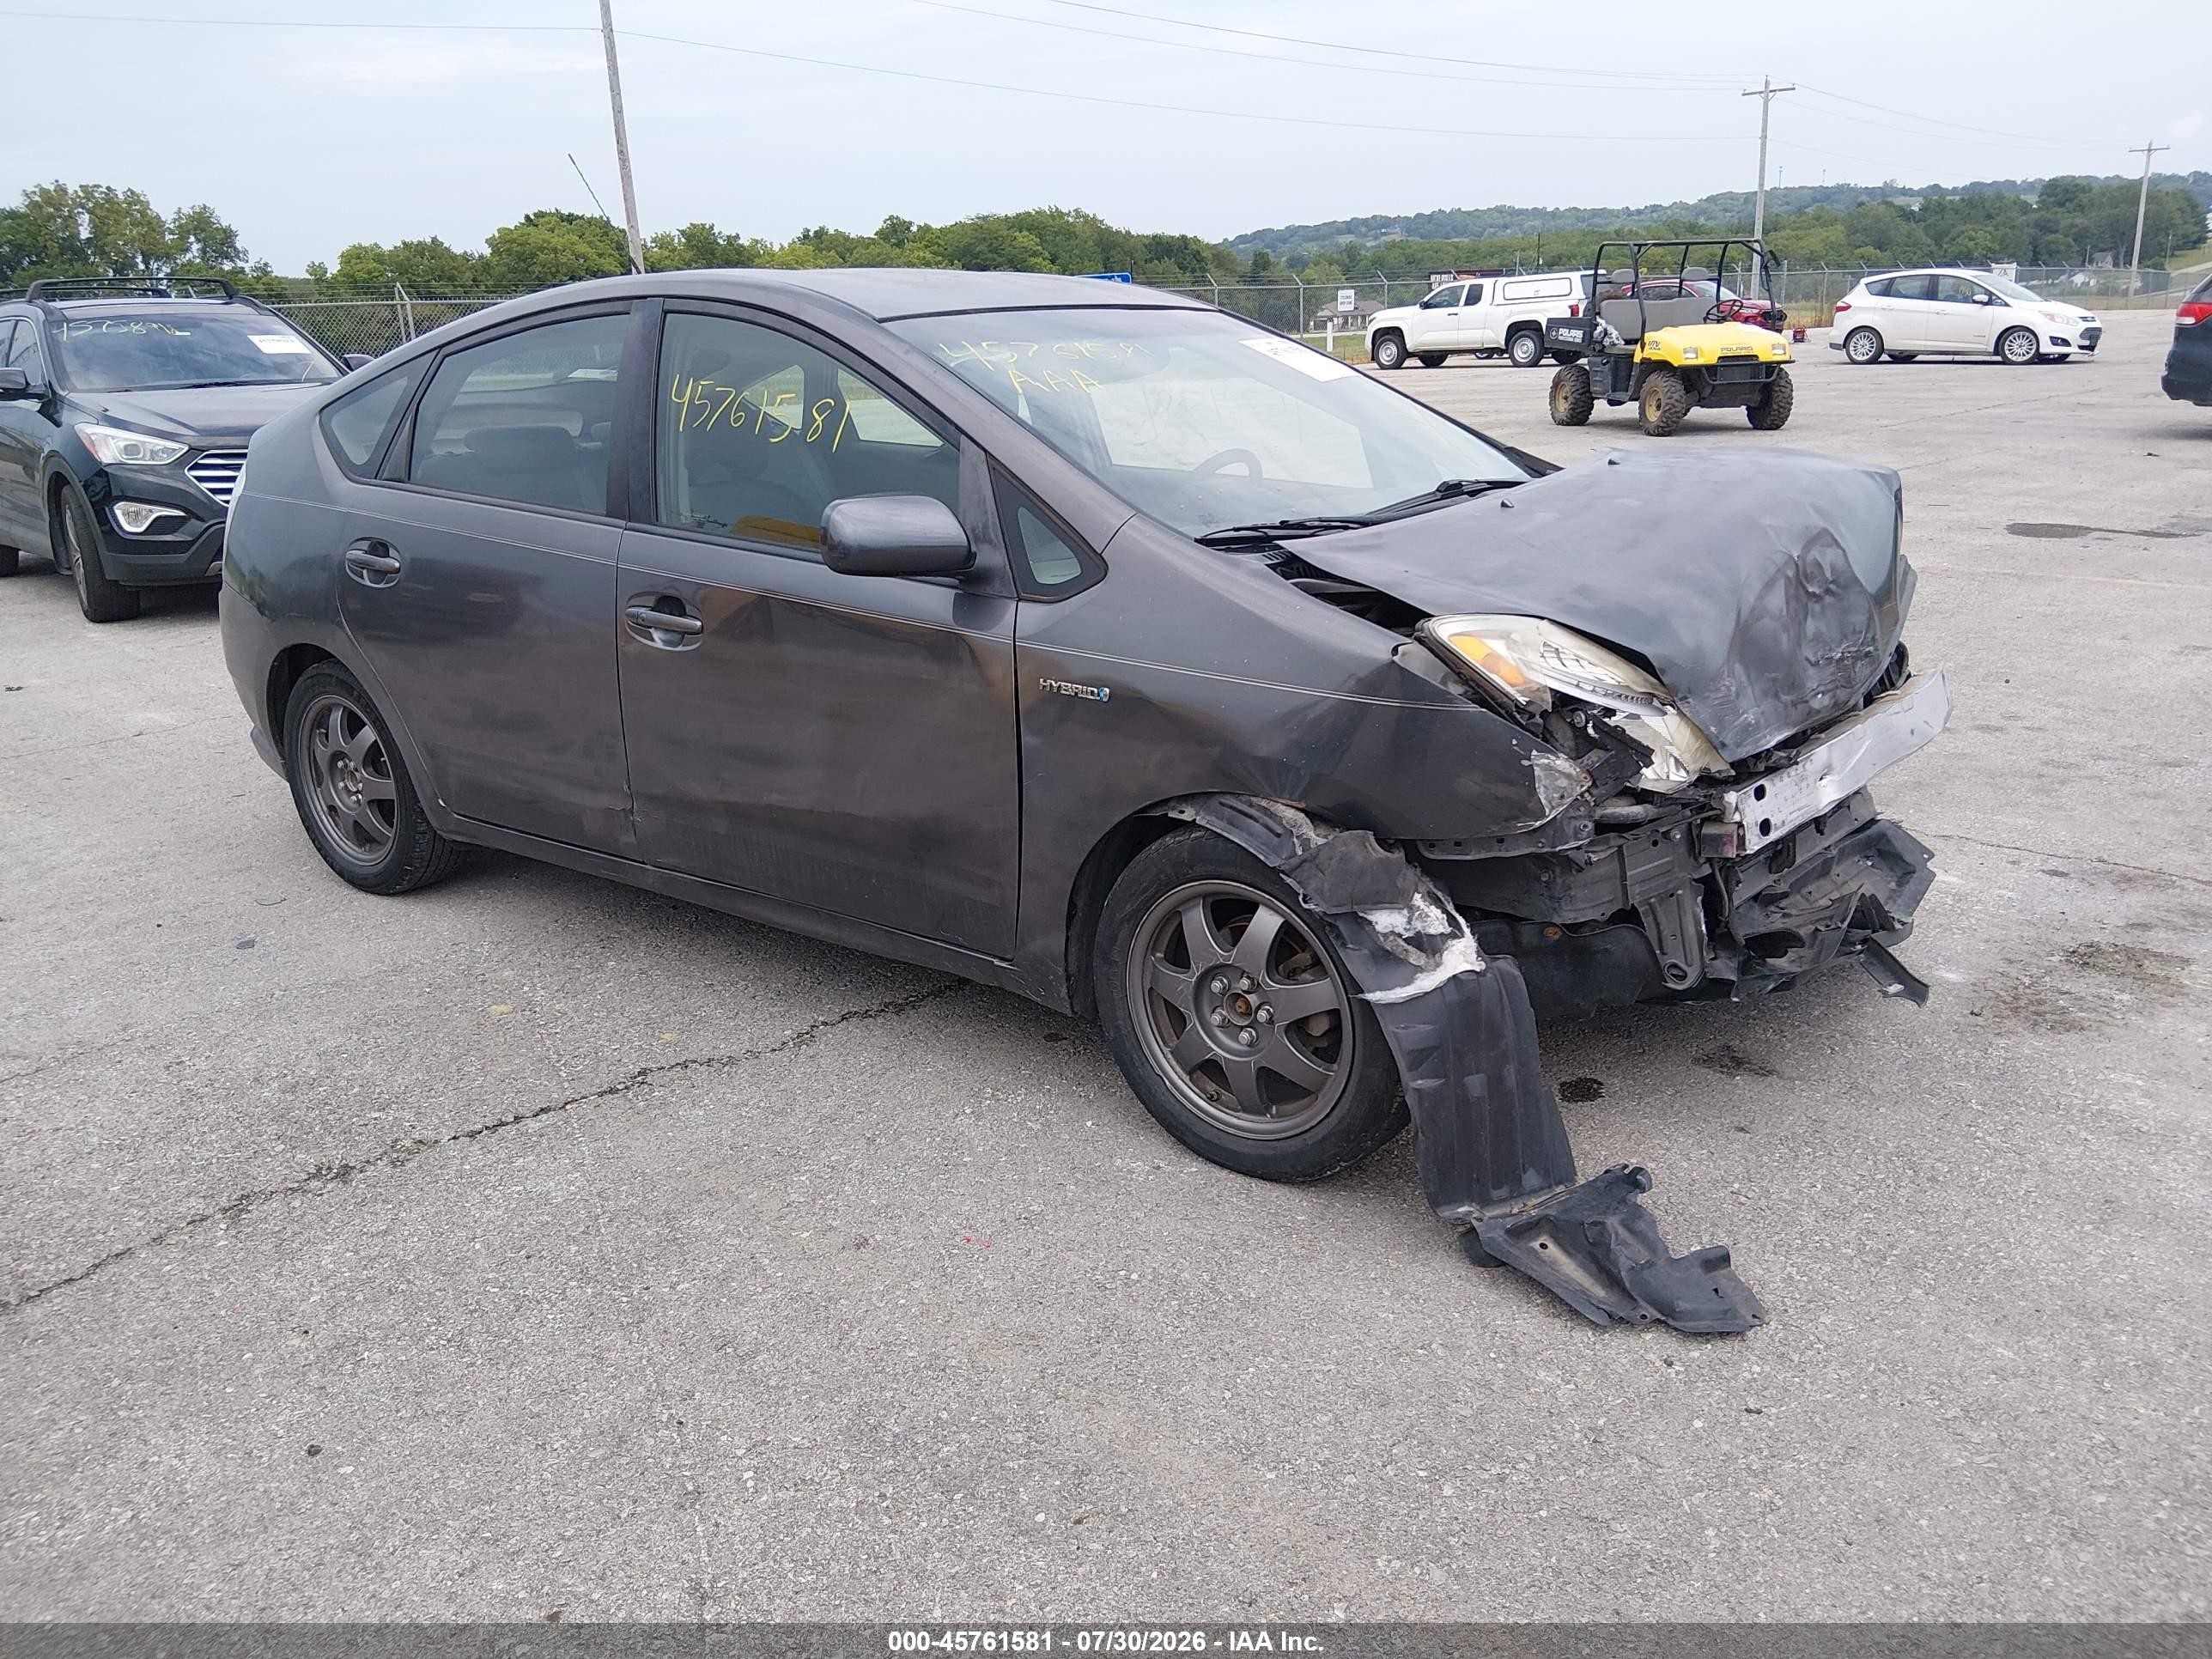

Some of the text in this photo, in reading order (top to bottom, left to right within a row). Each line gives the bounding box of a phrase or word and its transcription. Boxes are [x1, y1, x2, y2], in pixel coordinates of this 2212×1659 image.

[1559, 328, 1583, 338] POLARIS
[1007, 369, 1103, 393] AAA
[672, 374, 851, 453] 45761581
[1039, 678, 1100, 700] HYBRID
